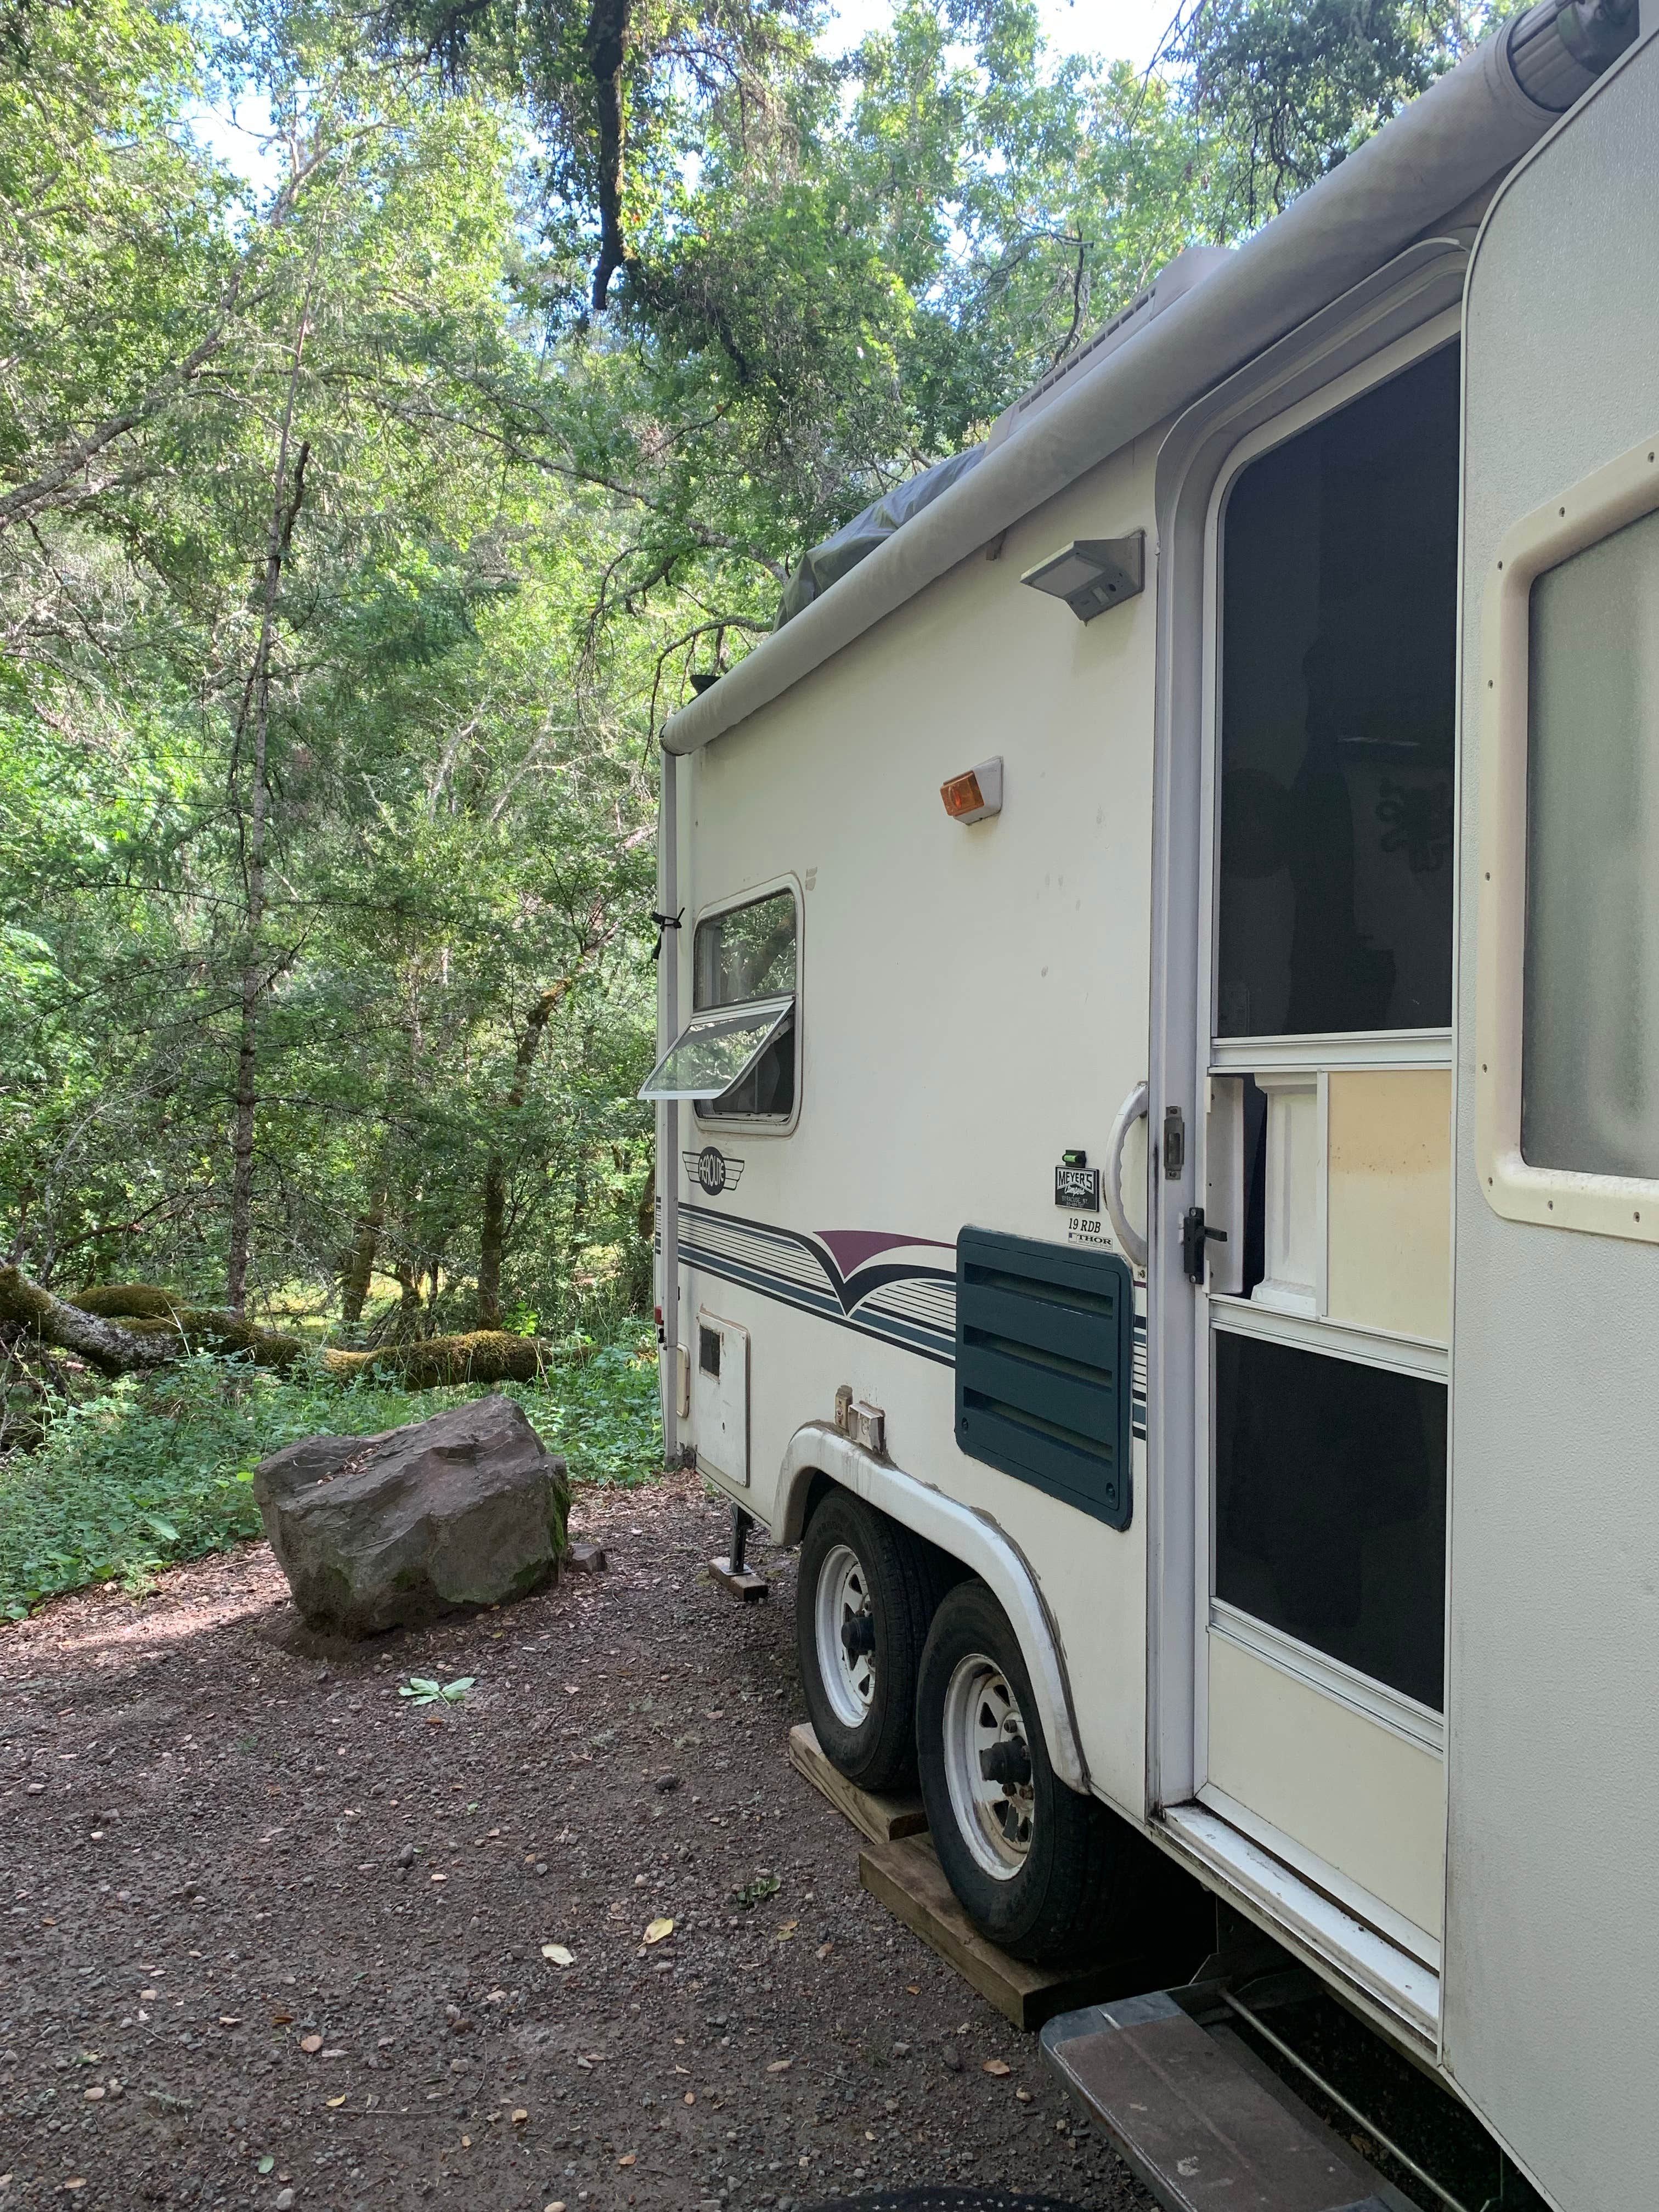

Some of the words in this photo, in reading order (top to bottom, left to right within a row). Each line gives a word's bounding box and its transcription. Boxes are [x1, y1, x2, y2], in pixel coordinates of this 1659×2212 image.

[1059, 1171, 1092, 1190] MEYER'S
[1069, 1218, 1079, 1230] 19
[1080, 1220, 1101, 1233] RDB
[1077, 1234, 1111, 1245] THOR
